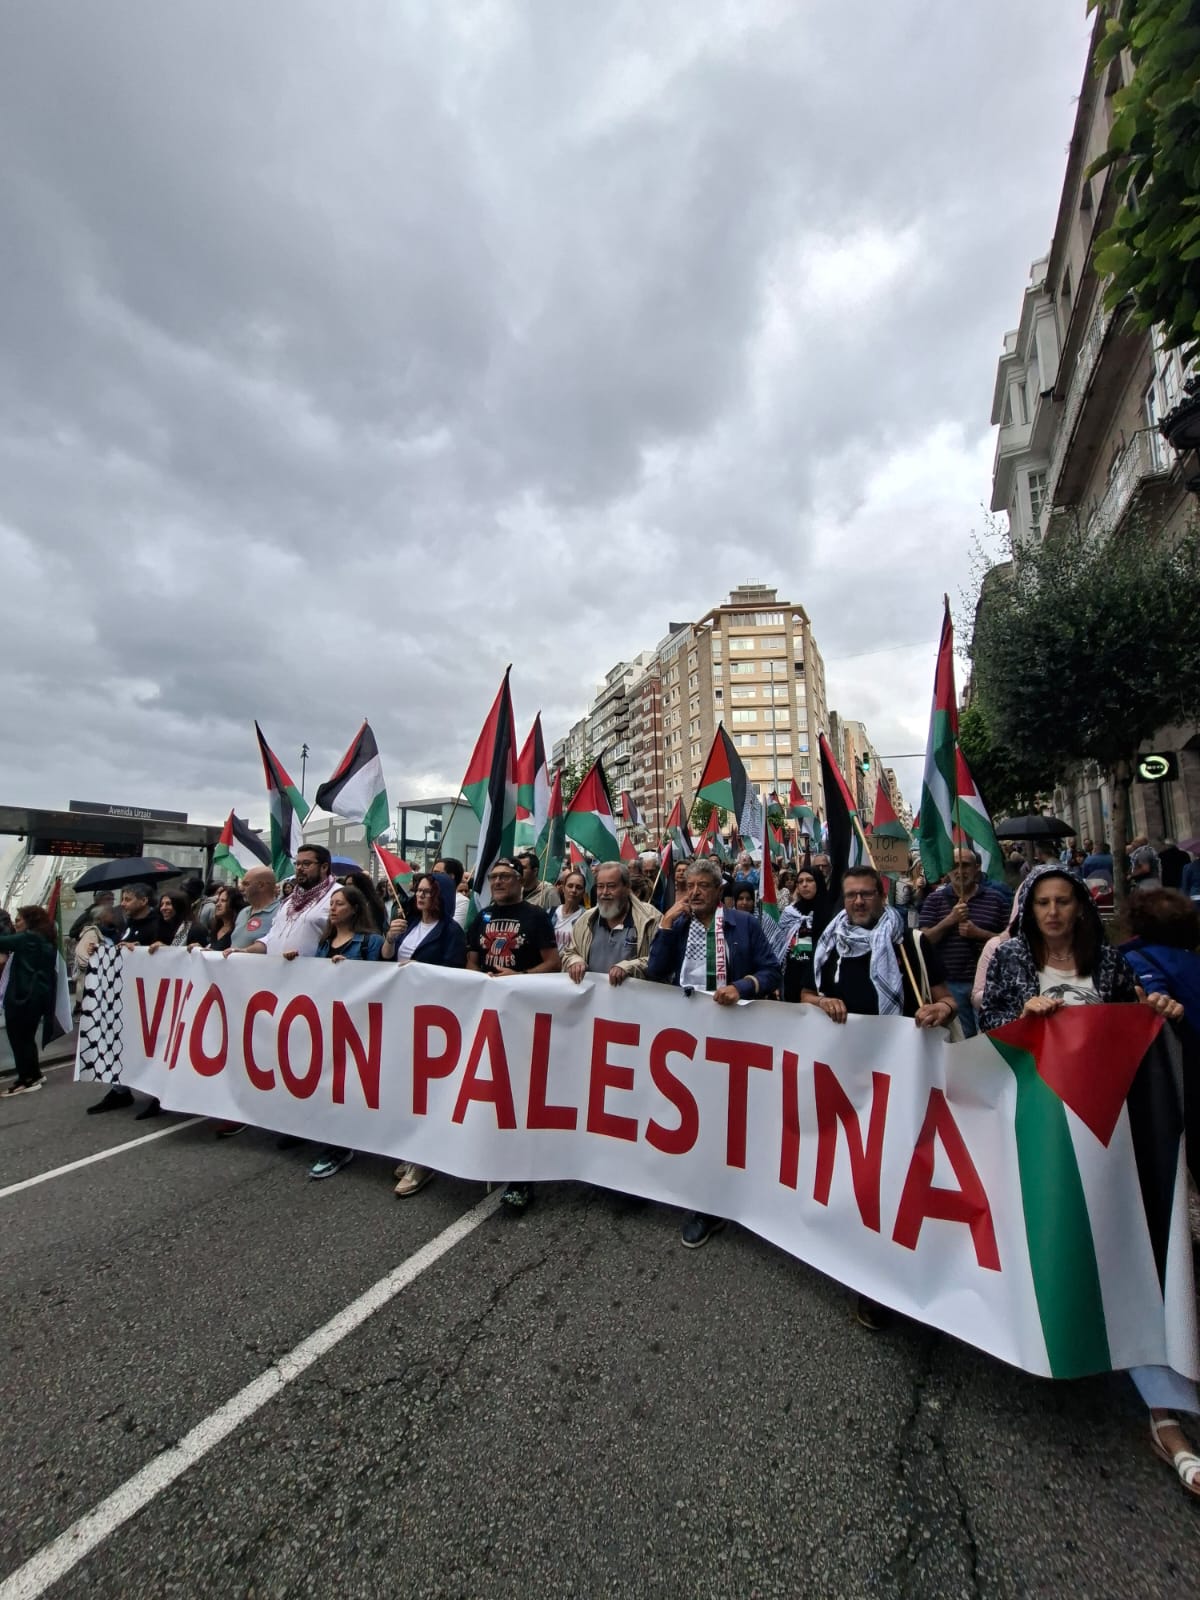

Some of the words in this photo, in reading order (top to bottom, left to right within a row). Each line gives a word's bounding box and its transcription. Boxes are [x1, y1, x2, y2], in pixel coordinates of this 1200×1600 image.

[108, 805, 133, 817] Avenida
[485, 921, 520, 934] ROLLING
[716, 916, 726, 981] PALESTINE
[242, 990, 383, 1110] CON
[412, 1004, 1002, 1272] PALESTINA
